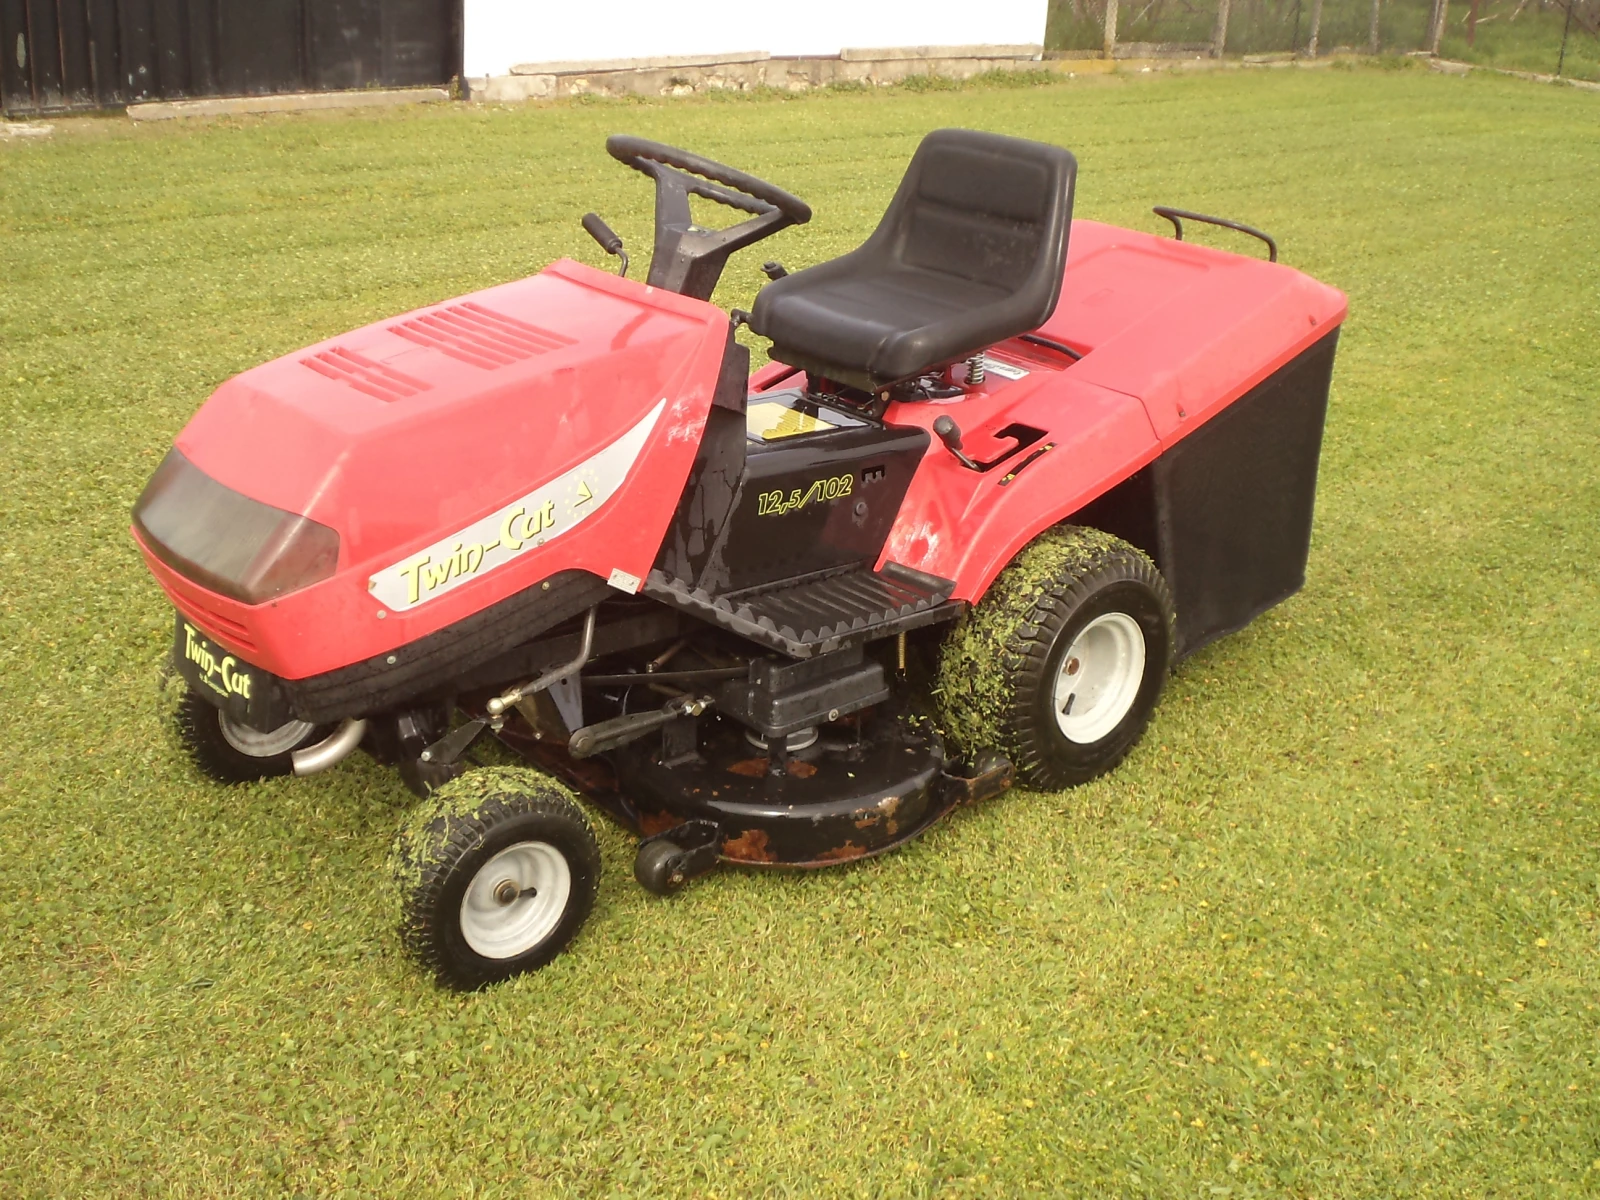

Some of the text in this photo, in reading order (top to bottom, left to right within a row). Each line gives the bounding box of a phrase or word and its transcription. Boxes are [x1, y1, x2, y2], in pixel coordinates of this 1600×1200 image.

[758, 473, 854, 516] 12,5/102
[400, 499, 556, 604] Twin-Cut
[183, 623, 251, 699] Twin-Cut
